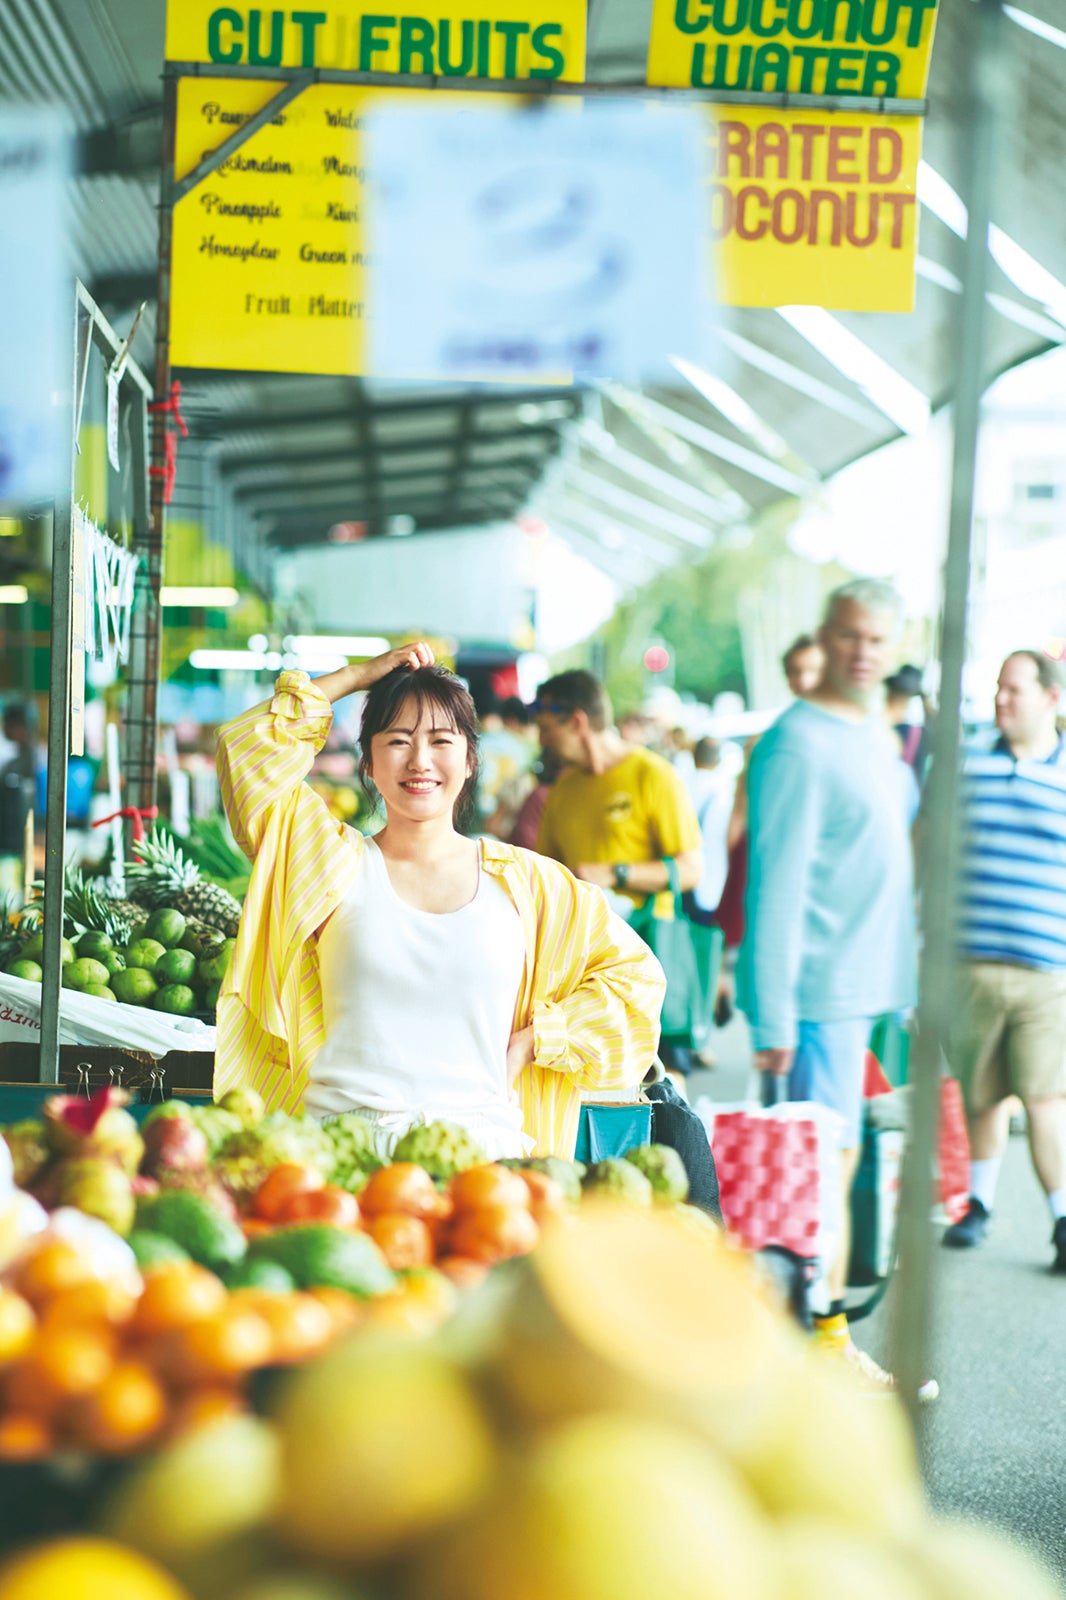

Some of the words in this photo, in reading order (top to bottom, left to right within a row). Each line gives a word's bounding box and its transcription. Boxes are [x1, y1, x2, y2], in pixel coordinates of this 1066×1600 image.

[674, 0, 937, 48] COCONUT
[207, 8, 327, 67] CUT
[359, 14, 565, 80] FRUITS
[690, 42, 901, 98] WATER
[708, 120, 903, 184] RATED
[200, 193, 281, 223] Pineapple
[326, 202, 359, 222] Kiwi
[707, 183, 916, 249] OCONUT
[199, 234, 277, 262] Honeydew
[300, 243, 346, 263] Green
[245, 293, 290, 315] Fruit
